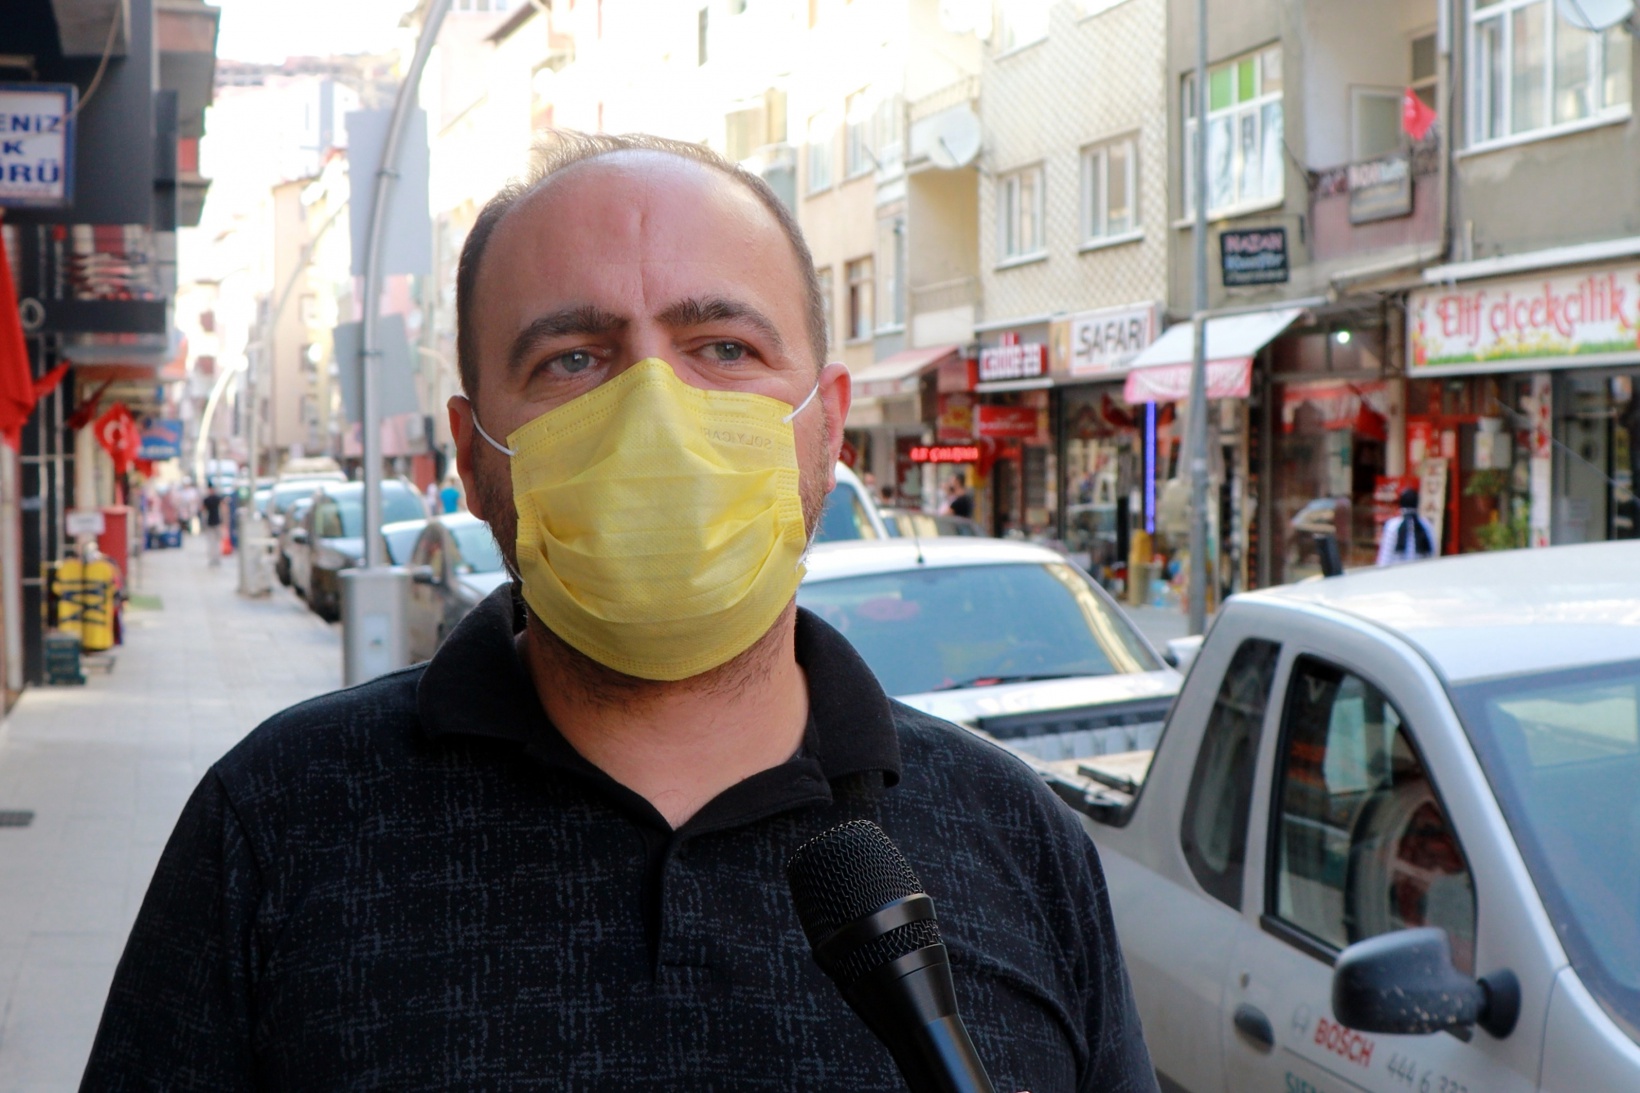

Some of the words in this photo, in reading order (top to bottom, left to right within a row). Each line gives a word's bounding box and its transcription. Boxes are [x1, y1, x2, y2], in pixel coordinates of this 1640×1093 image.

[1076, 317, 1147, 360] SAFARI
[1436, 289, 1486, 347] Elif
[1490, 272, 1632, 344] çiçekçilik
[1314, 1016, 1375, 1068] BOSCH
[1387, 1053, 1416, 1085] 444
